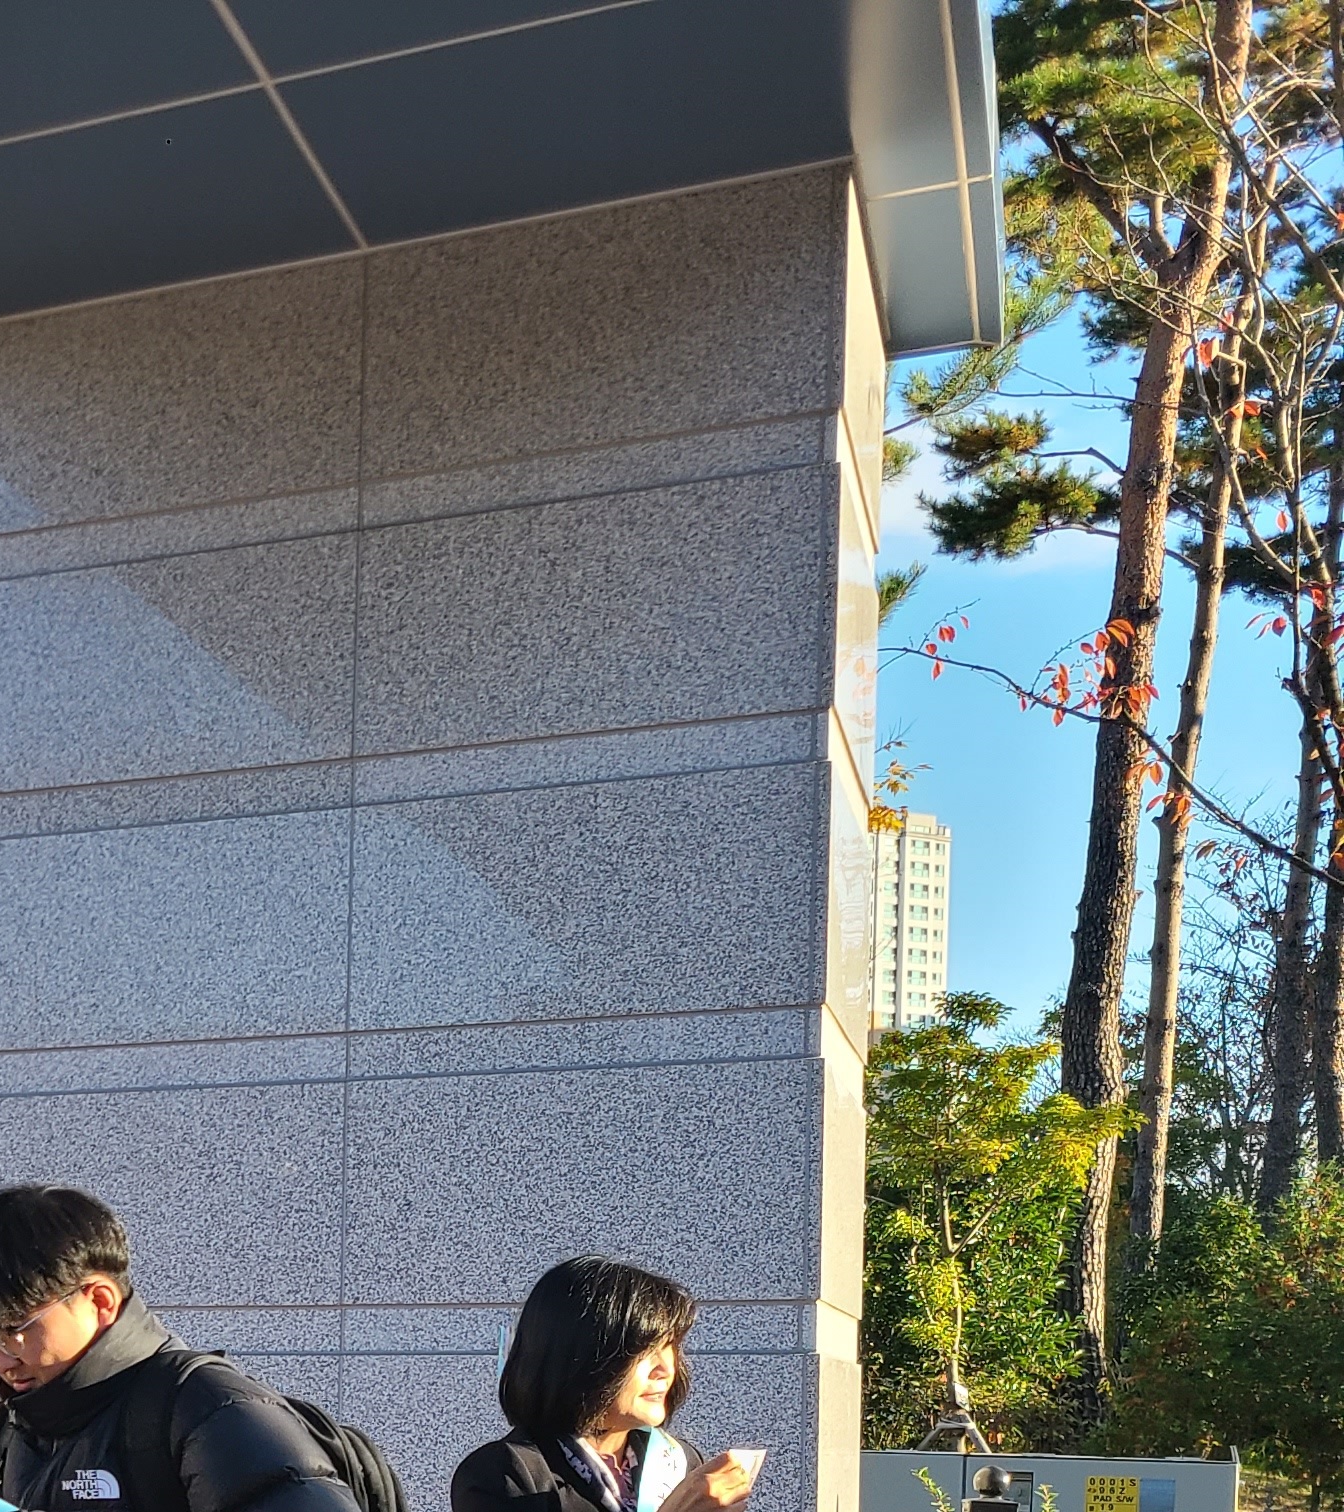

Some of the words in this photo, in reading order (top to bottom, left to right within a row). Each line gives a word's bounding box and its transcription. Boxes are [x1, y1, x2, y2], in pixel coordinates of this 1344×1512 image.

[75, 1470, 97, 1480] THE
[61, 1480, 97, 1490] NORTH
[72, 1490, 99, 1500] FACE
